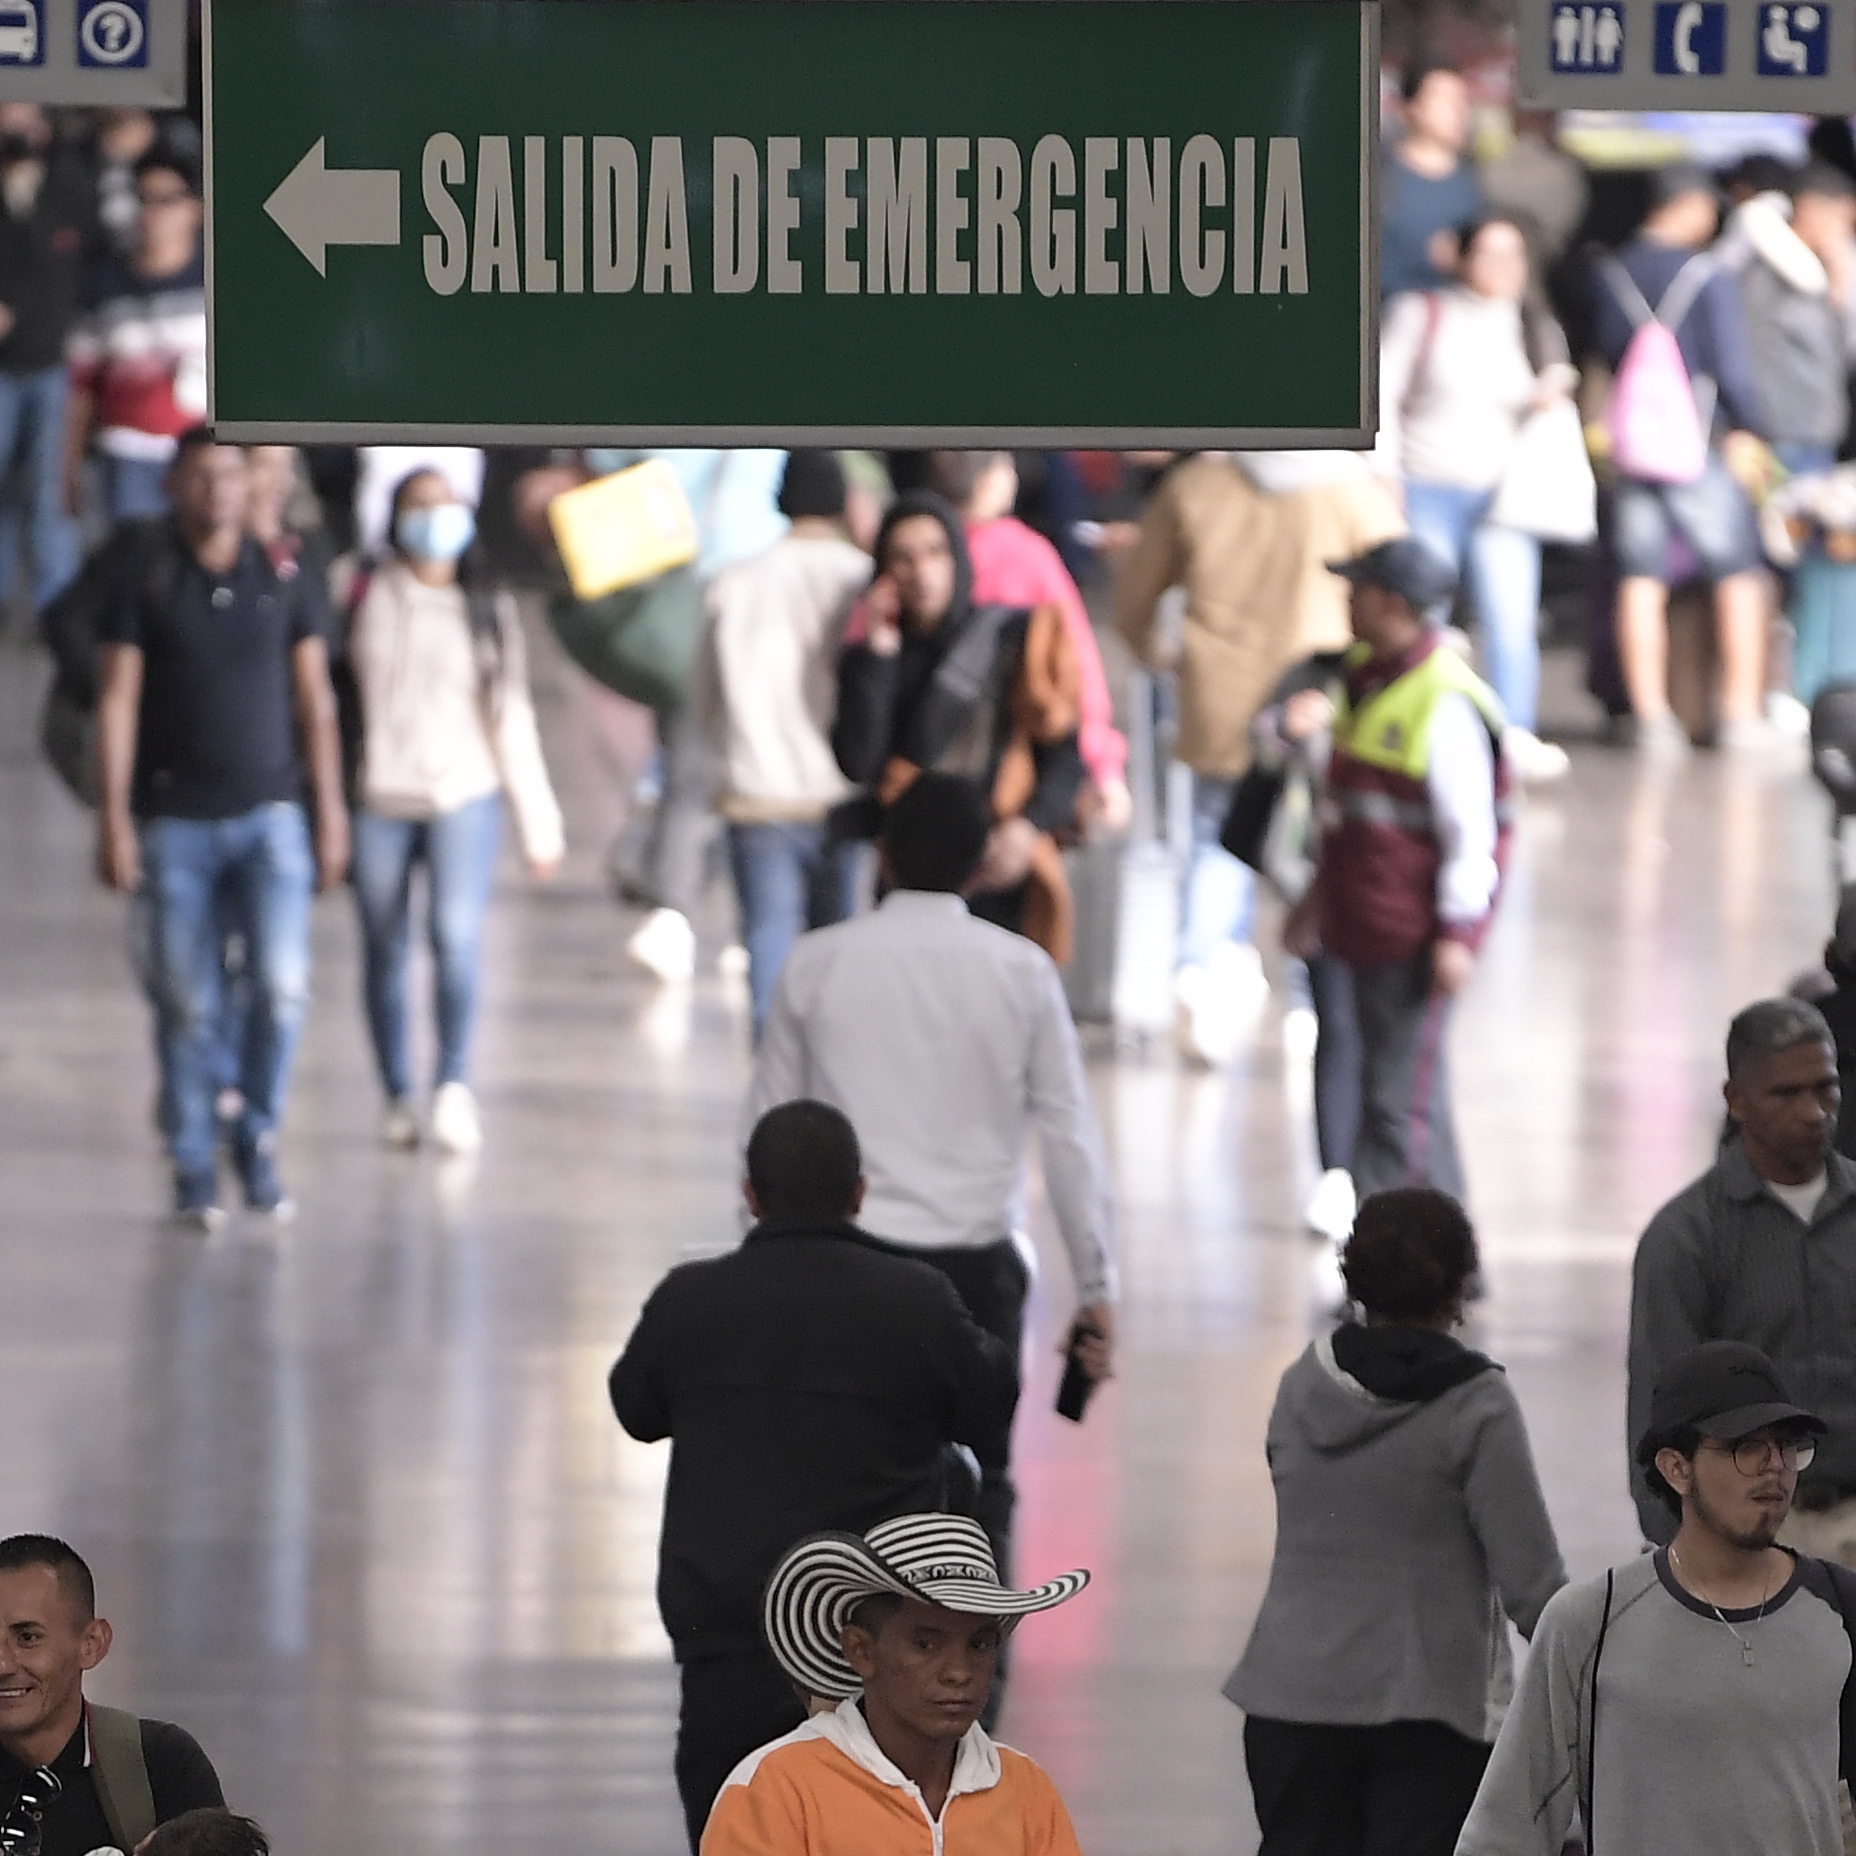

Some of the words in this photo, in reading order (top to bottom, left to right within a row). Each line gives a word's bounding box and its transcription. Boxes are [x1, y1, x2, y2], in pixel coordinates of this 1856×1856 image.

[420, 131, 694, 296] SALIDA
[712, 134, 803, 295] DE
[823, 132, 1310, 298] EMERGENCIA
